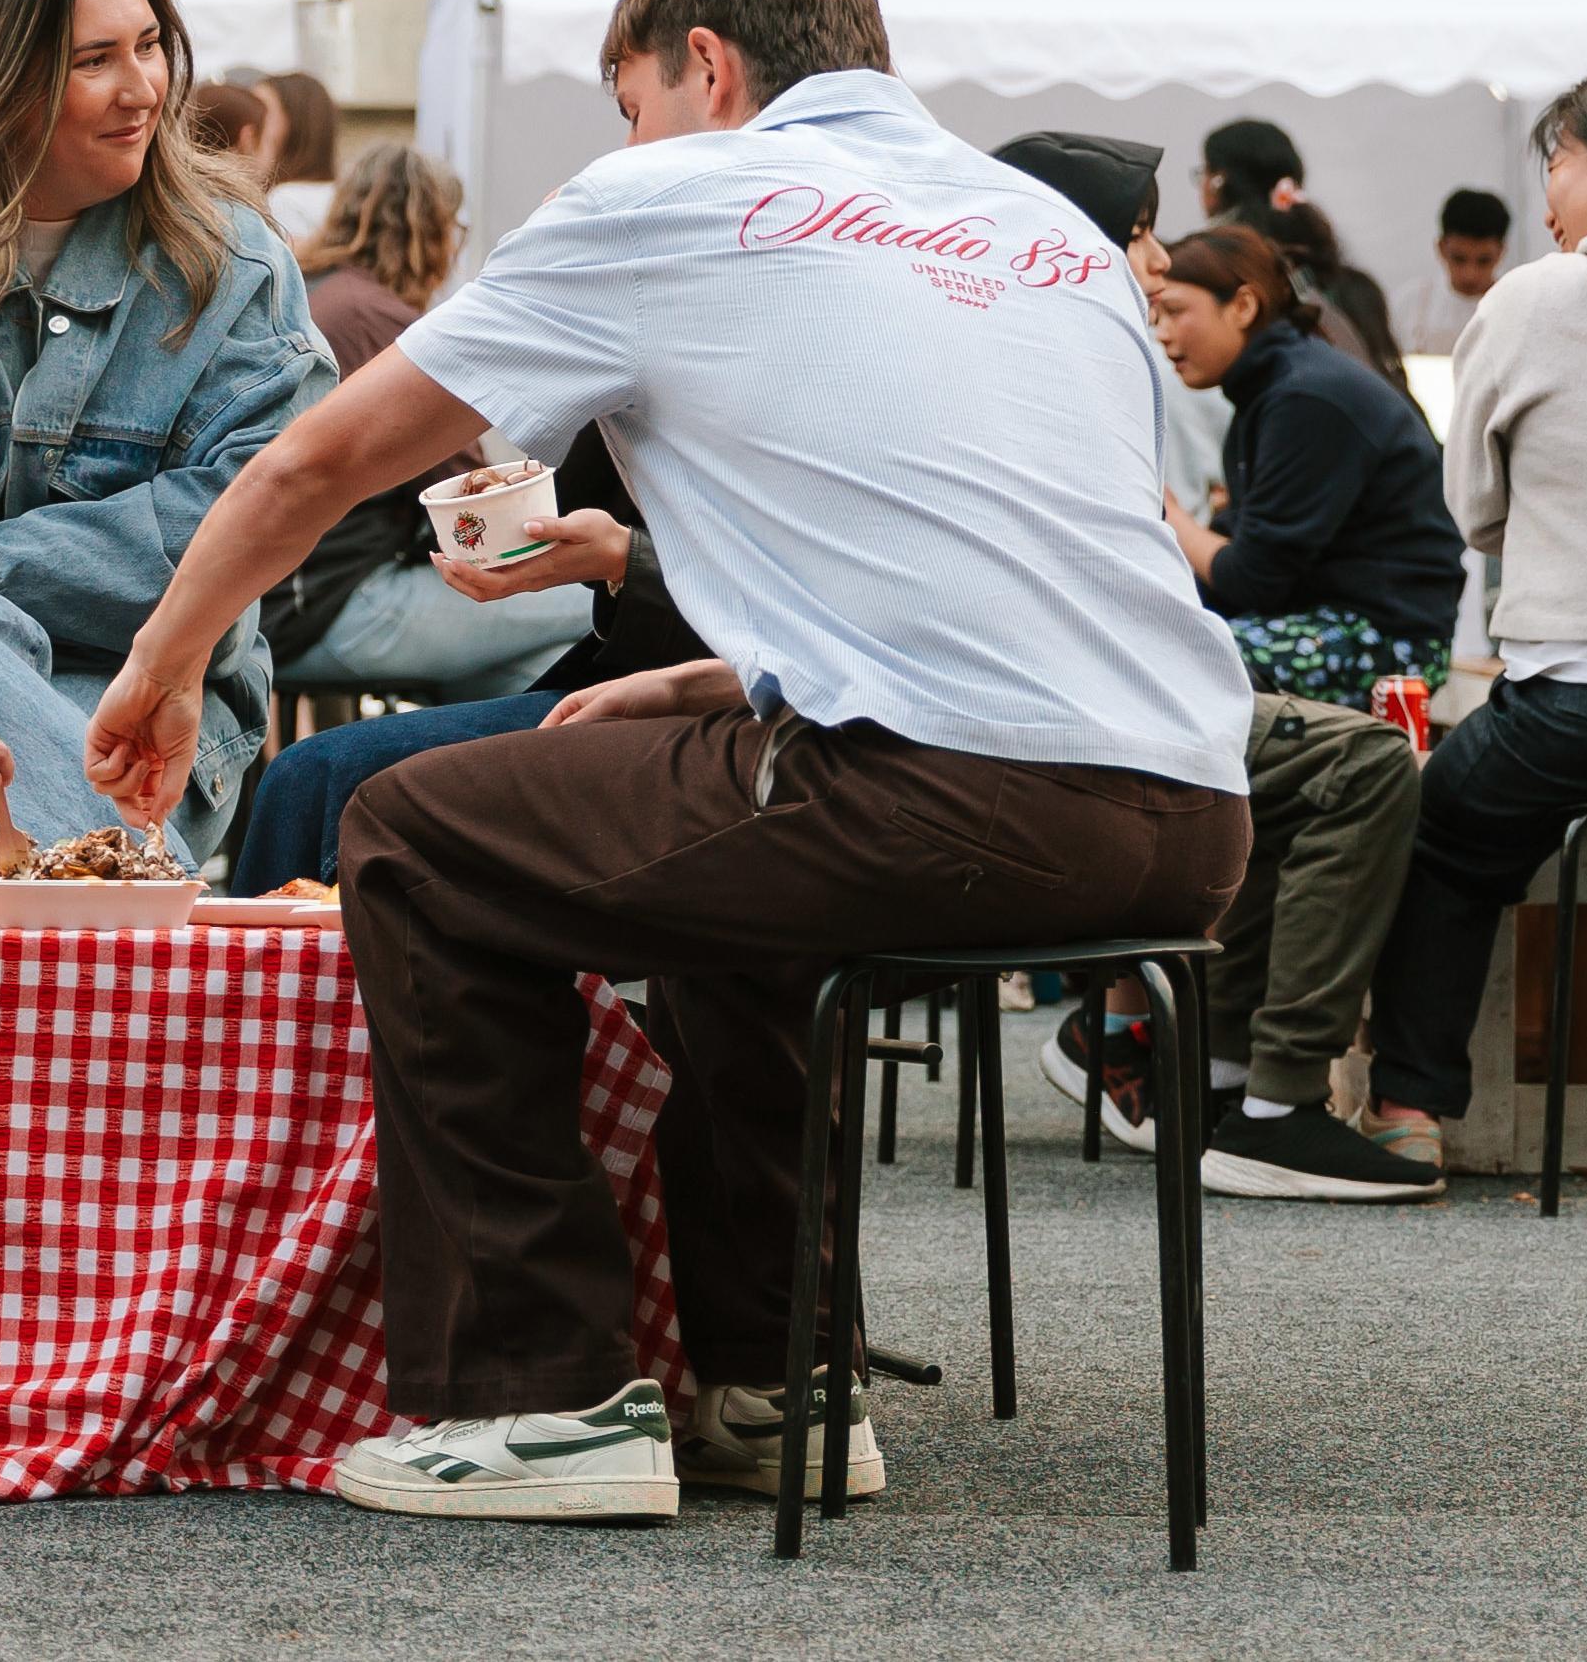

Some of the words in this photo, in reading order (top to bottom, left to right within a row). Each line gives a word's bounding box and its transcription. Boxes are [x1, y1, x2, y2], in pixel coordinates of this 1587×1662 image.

[740, 185, 997, 261] Studio
[1009, 228, 1111, 288] 858
[911, 262, 1006, 292] UNTITLED
[930, 277, 998, 301] SERIES
